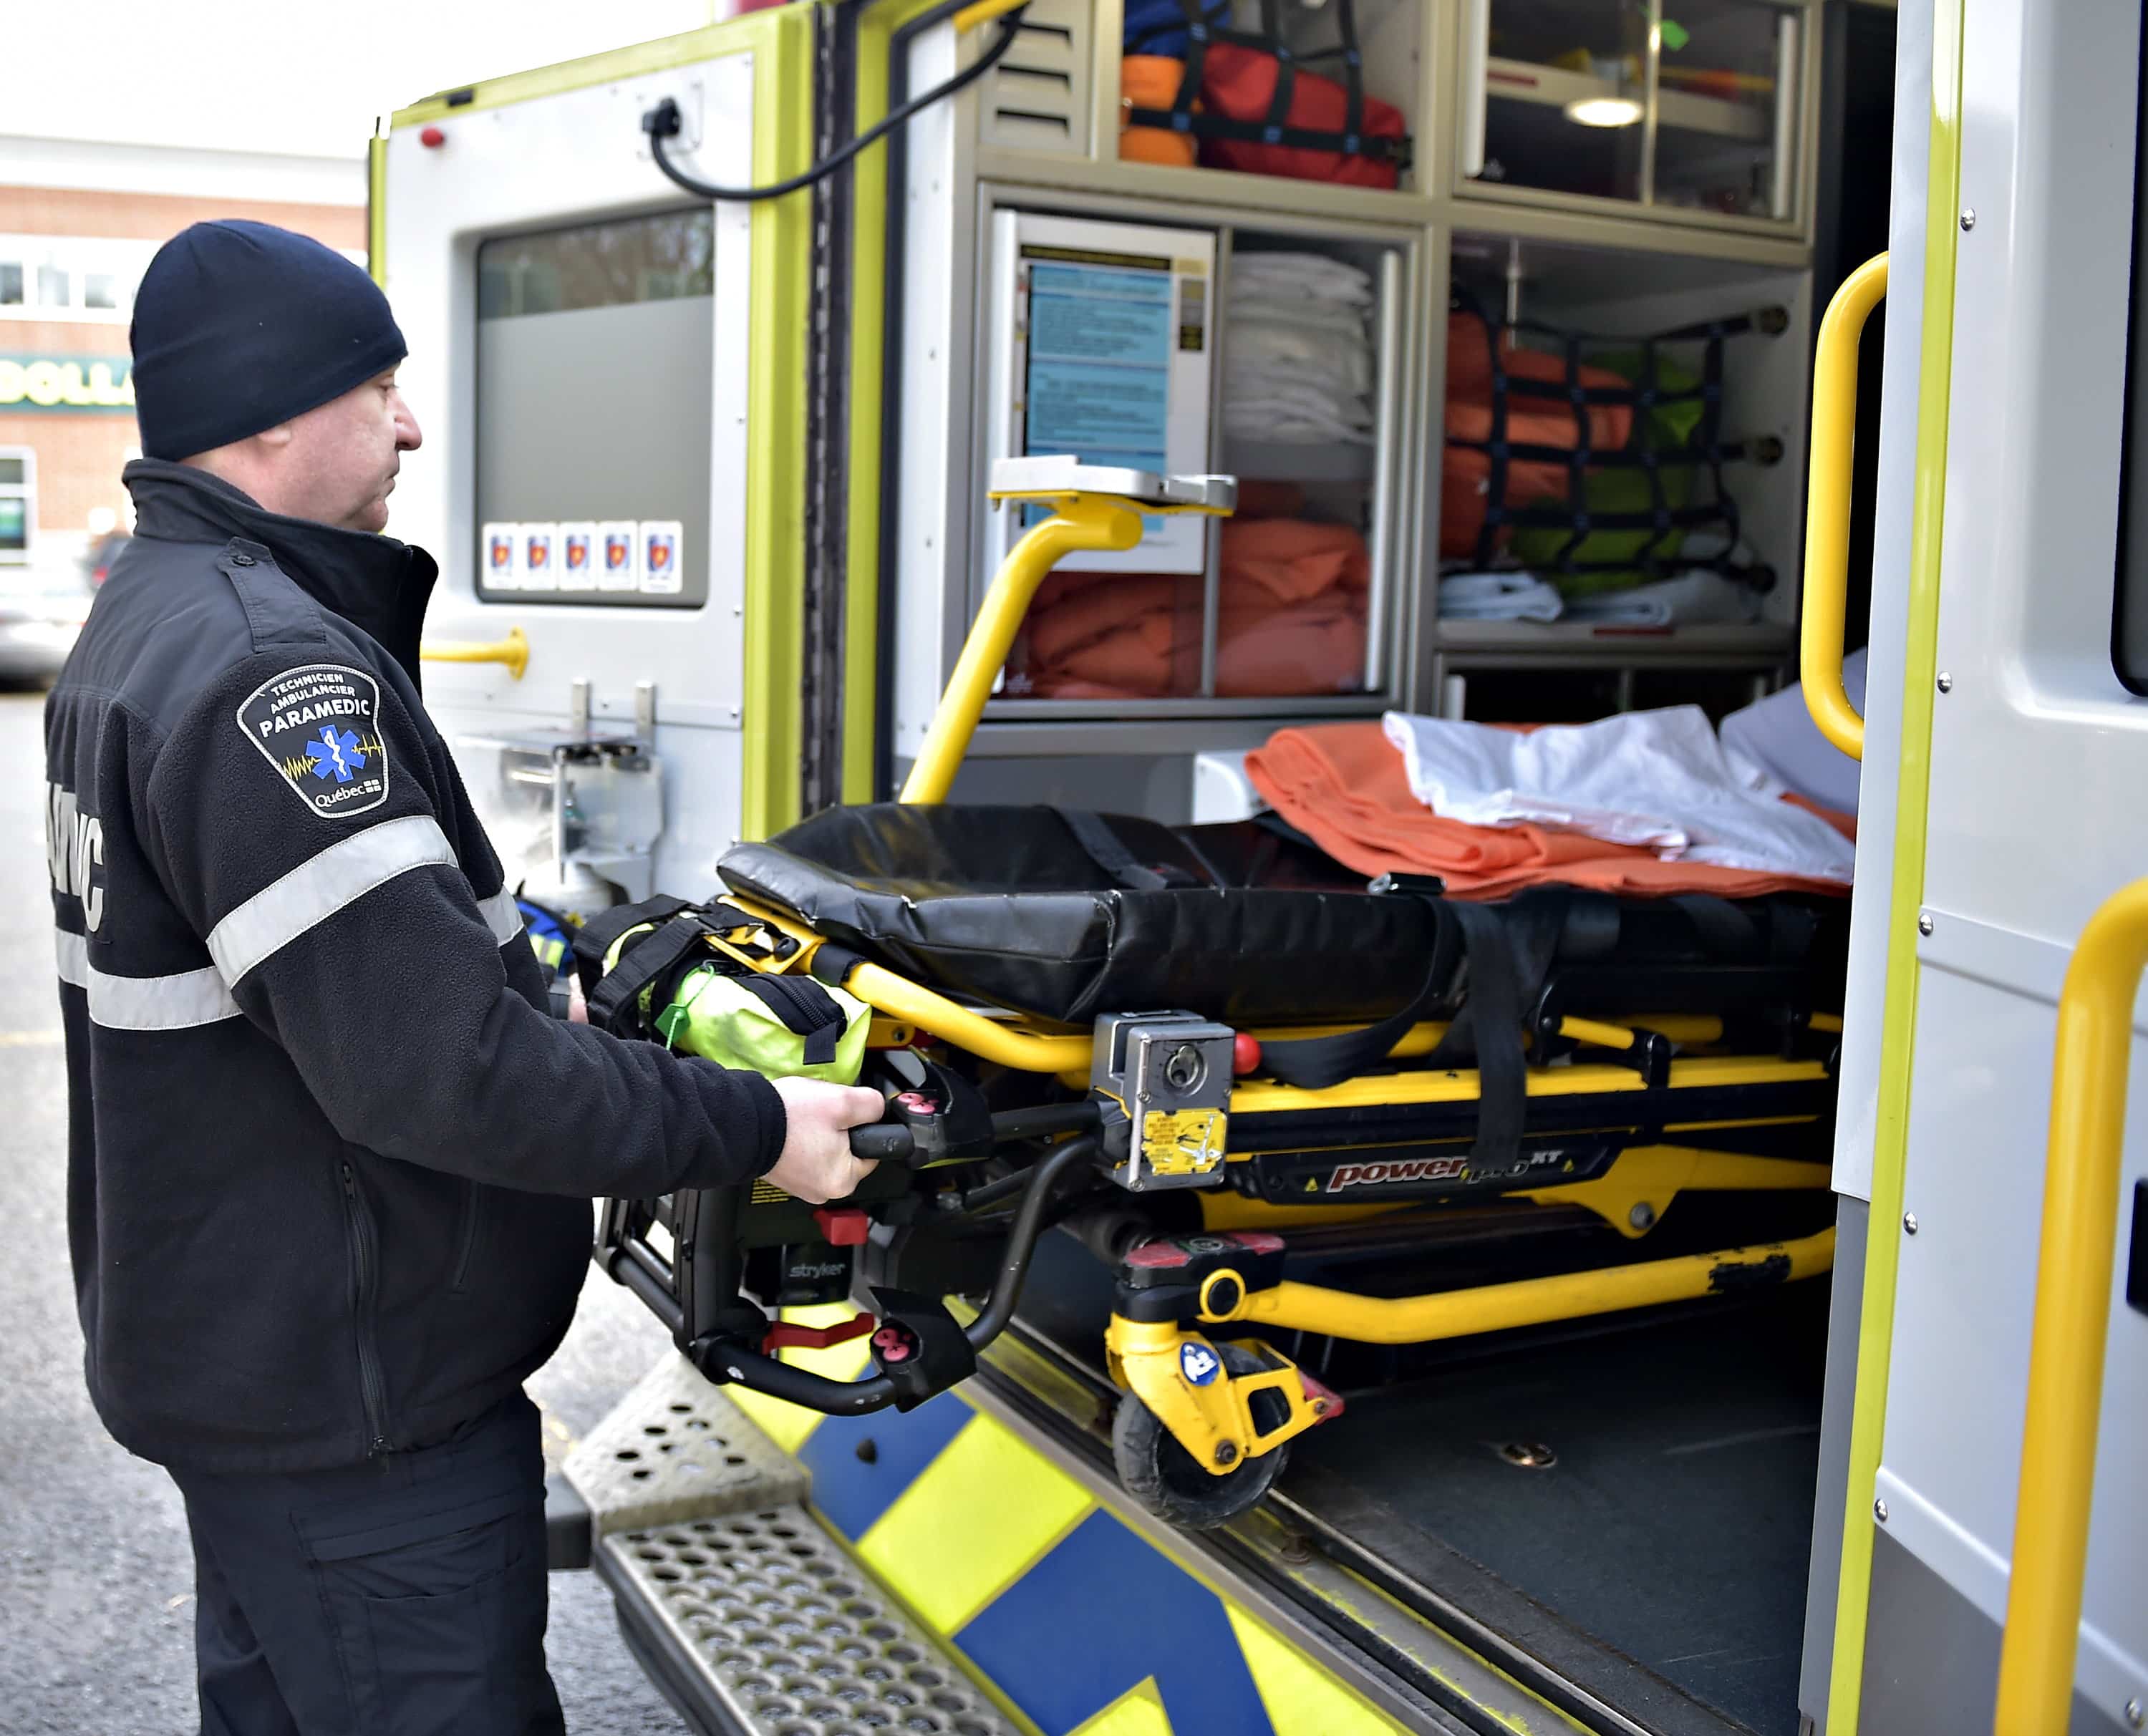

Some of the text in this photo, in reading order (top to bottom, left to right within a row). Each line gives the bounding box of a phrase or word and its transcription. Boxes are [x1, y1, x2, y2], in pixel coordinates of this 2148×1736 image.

[270, 673, 344, 697] TECHNICIEN
[270, 684, 355, 714] AMBULANCIER
[258, 699, 371, 738] PARAMEDIC
[314, 784, 366, 808] Québec
[1530, 1150, 1564, 1165] XT
[788, 1261, 846, 1279] stryker
